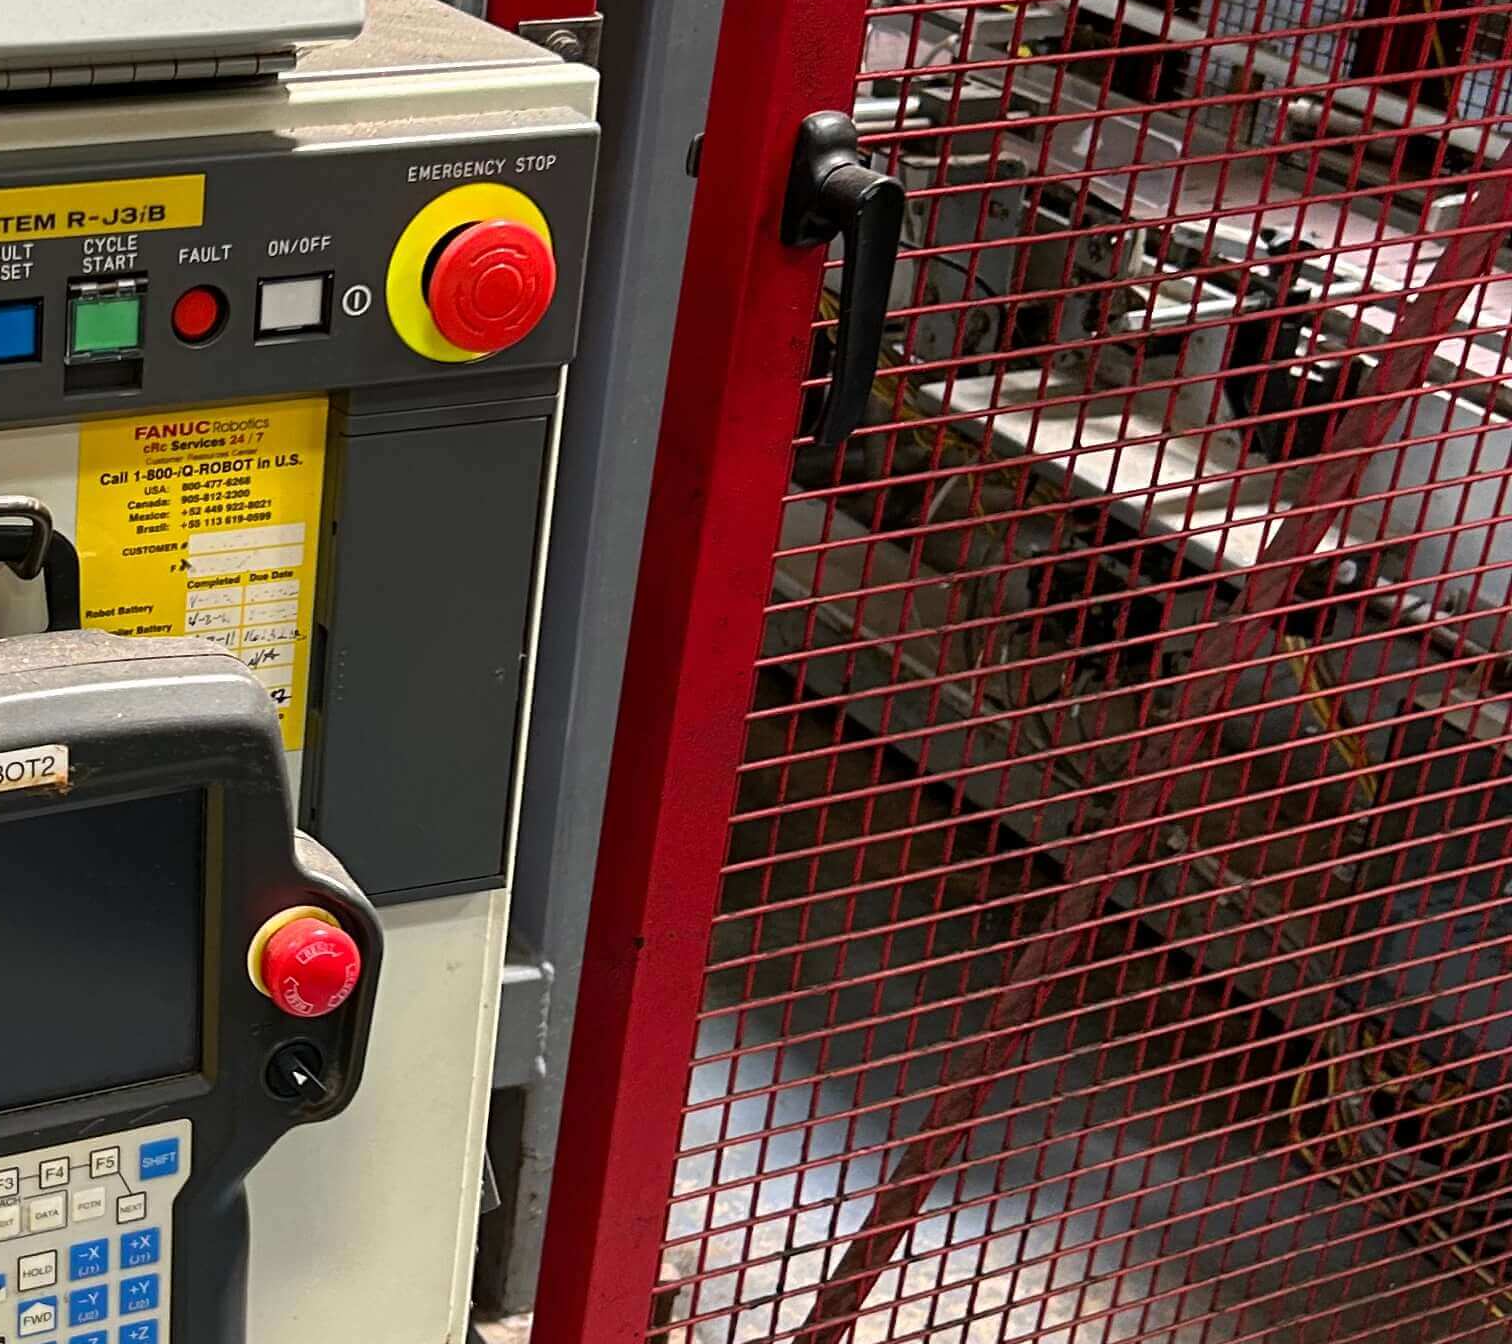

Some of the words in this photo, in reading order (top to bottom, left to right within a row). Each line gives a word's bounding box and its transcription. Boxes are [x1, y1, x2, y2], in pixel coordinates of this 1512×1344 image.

[407, 158, 506, 183] EMERGENCY
[515, 155, 557, 173] STOP
[83, 235, 138, 255] CYCLE
[267, 236, 332, 257] ON/OFF
[179, 244, 232, 264] FAULT
[82, 253, 137, 274] START
[135, 421, 210, 440] FANUC
[212, 418, 269, 433] Robotics
[171, 437, 225, 452] Services
[100, 472, 128, 486] Call
[257, 457, 270, 469] in
[274, 453, 303, 468] U.S.
[122, 543, 178, 557] CUSTOMER
[187, 575, 241, 590] Completed
[249, 572, 268, 582] Due
[271, 569, 294, 579] Date
[86, 608, 115, 619] Robot
[117, 605, 154, 616] Battery
[136, 623, 173, 635] Battery
[96, 1155, 115, 1171] F5
[142, 1151, 176, 1168] SHIFT
[46, 1167, 64, 1182] F4
[35, 1209, 59, 1220] DATA
[130, 1235, 151, 1249] +X
[22, 1264, 53, 1278] HOLD
[130, 1280, 151, 1295] +Y
[23, 1311, 53, 1326] FWD
[128, 1326, 150, 1340] +Z
